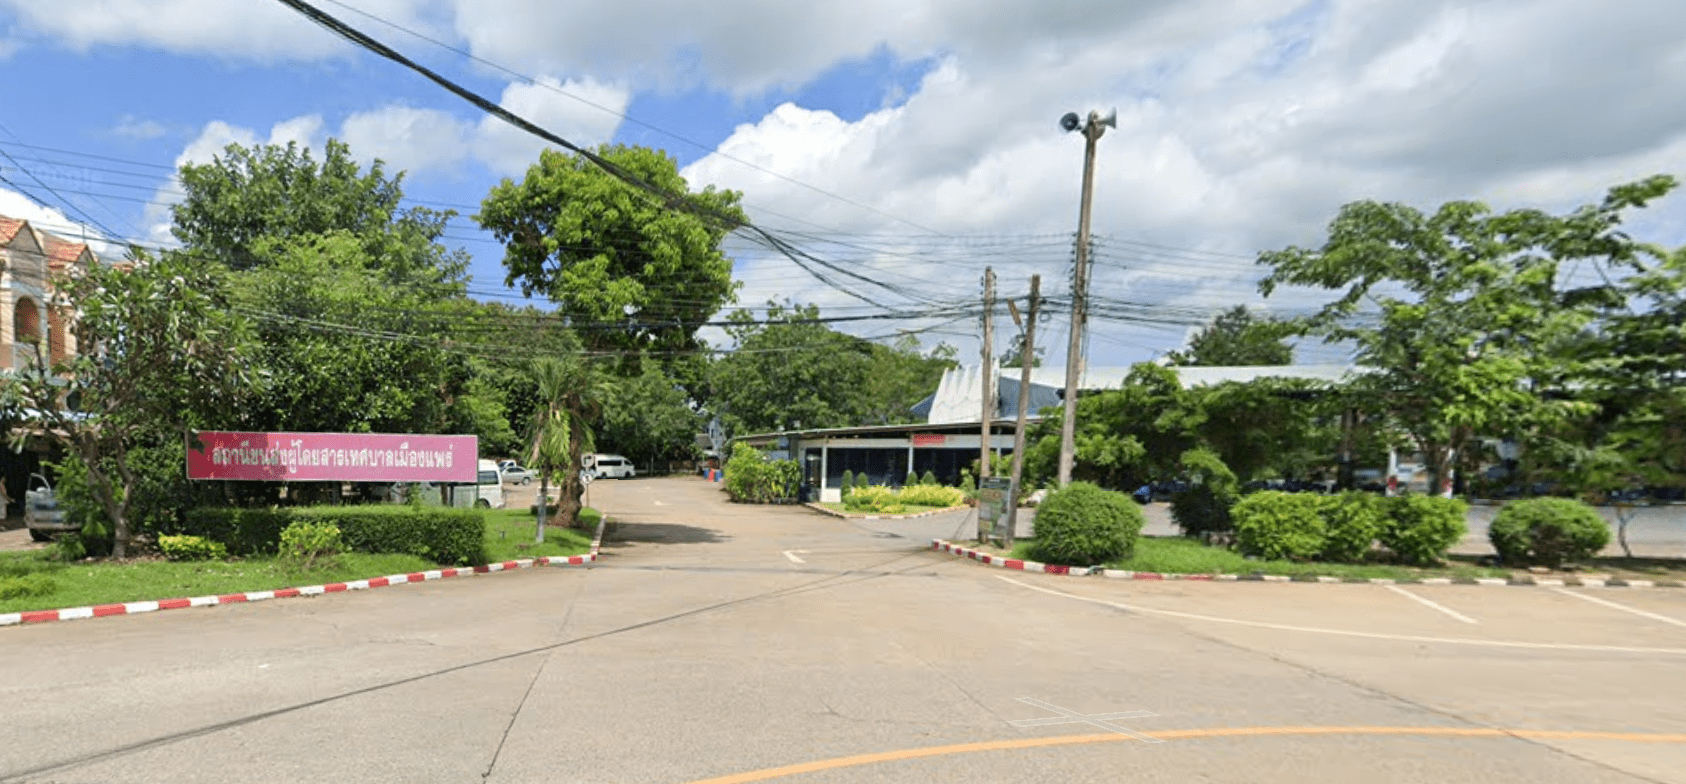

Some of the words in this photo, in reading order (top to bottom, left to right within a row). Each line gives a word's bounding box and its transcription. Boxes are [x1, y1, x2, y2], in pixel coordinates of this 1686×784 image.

[212, 439, 453, 474] สถานีขนส่งผู้โดยสารเทศบาลเมืองแพร่
